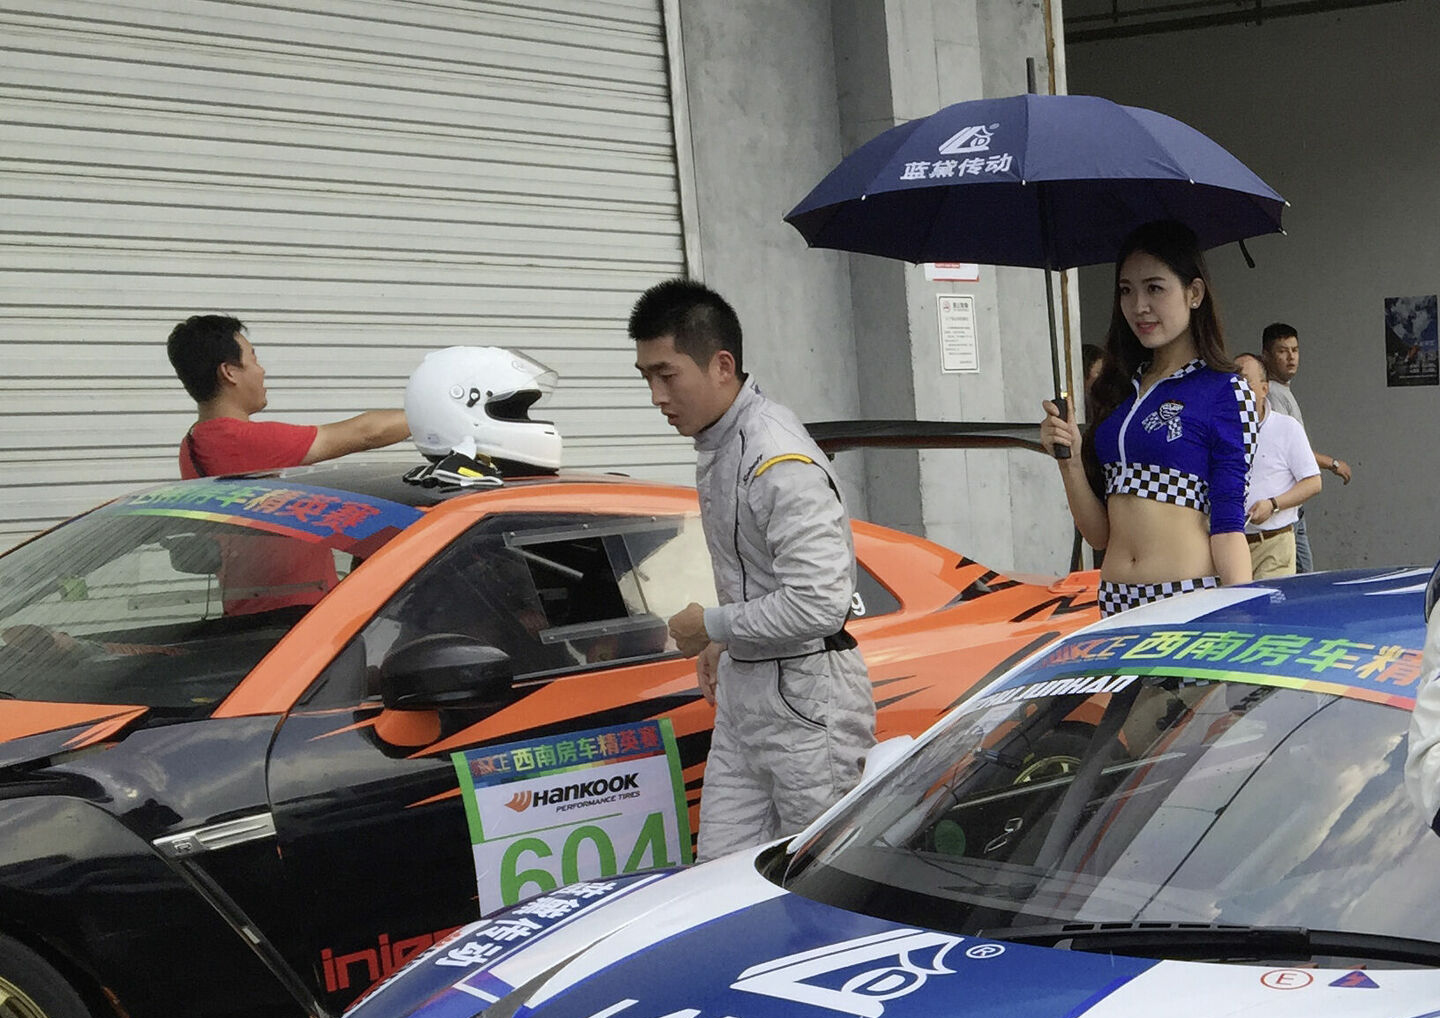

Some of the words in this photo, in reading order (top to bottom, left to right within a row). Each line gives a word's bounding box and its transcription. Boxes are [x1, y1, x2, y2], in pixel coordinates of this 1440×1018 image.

[900, 153, 1013, 180] 蓝黛传动
[512, 726, 661, 772] 西南房车精英赛
[556, 796, 617, 813] PERFORMANCE
[617, 791, 641, 802] TIRES
[500, 812, 677, 908] 604
